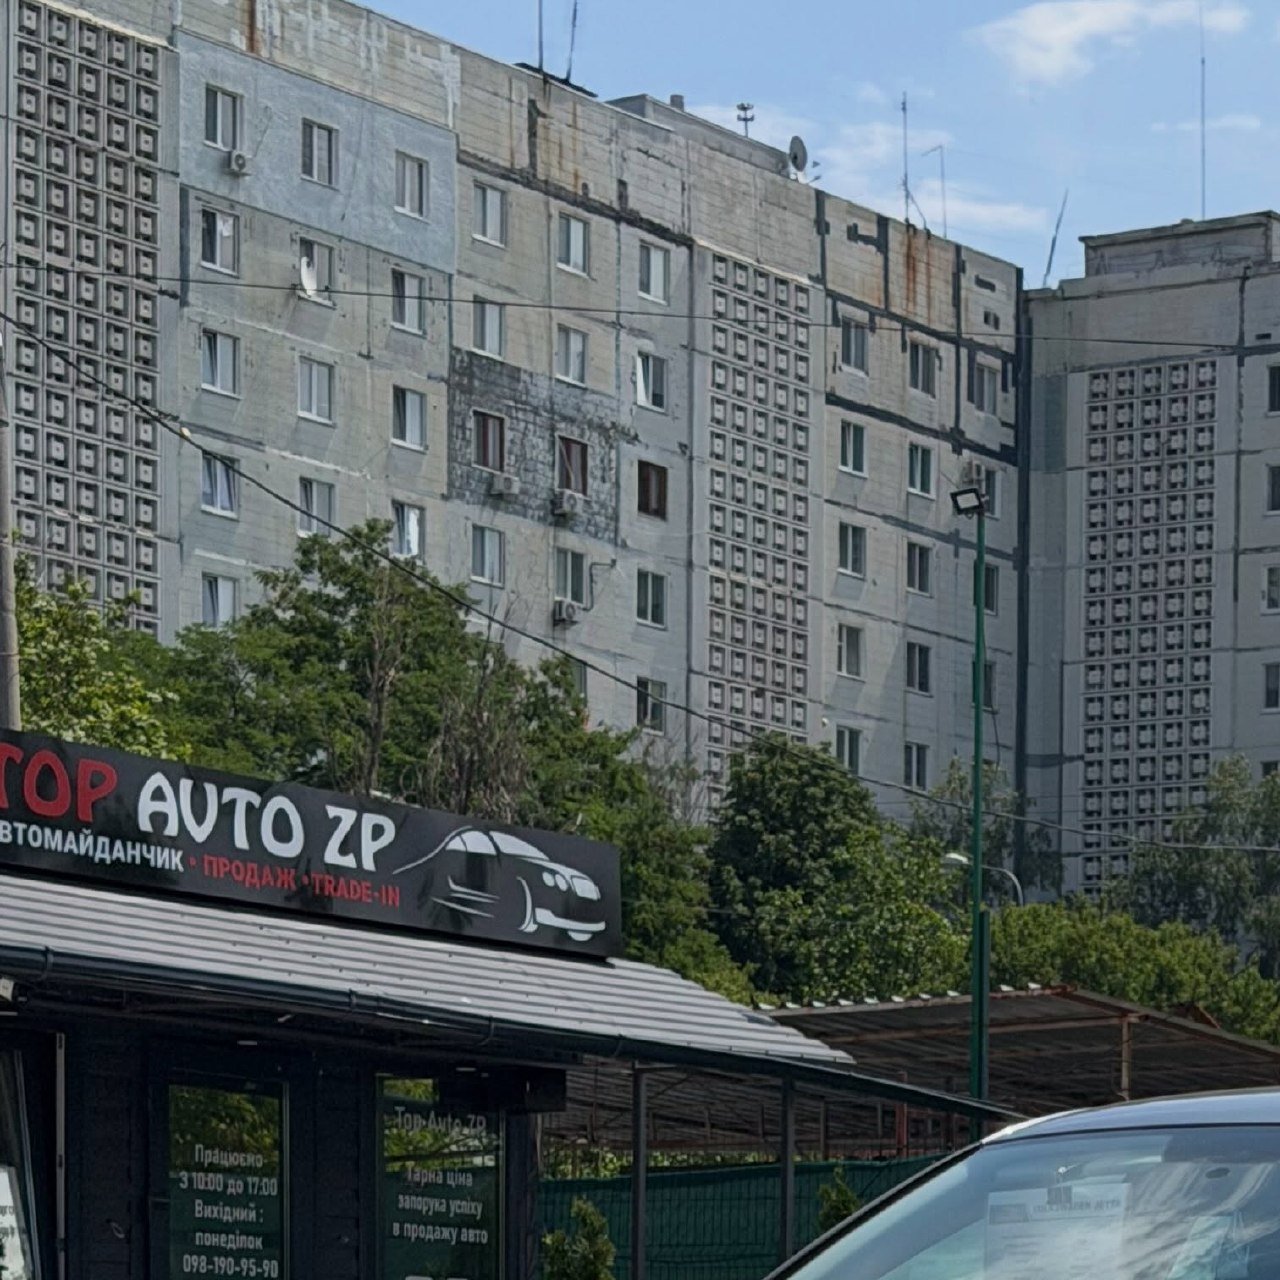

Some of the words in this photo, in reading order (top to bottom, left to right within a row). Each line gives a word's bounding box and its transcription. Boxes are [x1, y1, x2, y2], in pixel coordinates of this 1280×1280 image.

[0, 742, 118, 822] TOP
[324, 804, 396, 872] ZP
[0, 820, 184, 872] ВТОМАЙДАНЧИК
[203, 854, 296, 890] ПРОДАЖ
[310, 873, 400, 907] TRADE-IN
[195, 1144, 263, 1168] Працюємо
[227, 1179, 244, 1195] до
[247, 1177, 278, 1196] 17:00
[447, 1168, 473, 1188] ціна
[195, 1199, 256, 1222] Вихідний
[398, 1194, 446, 1216] запорука
[449, 1197, 483, 1220] успіху
[195, 1229, 263, 1250] понеділок
[392, 1222, 400, 1236] в
[404, 1223, 458, 1245] продажу
[461, 1228, 488, 1244] авто
[183, 1254, 278, 1278] 098-190-95-90
